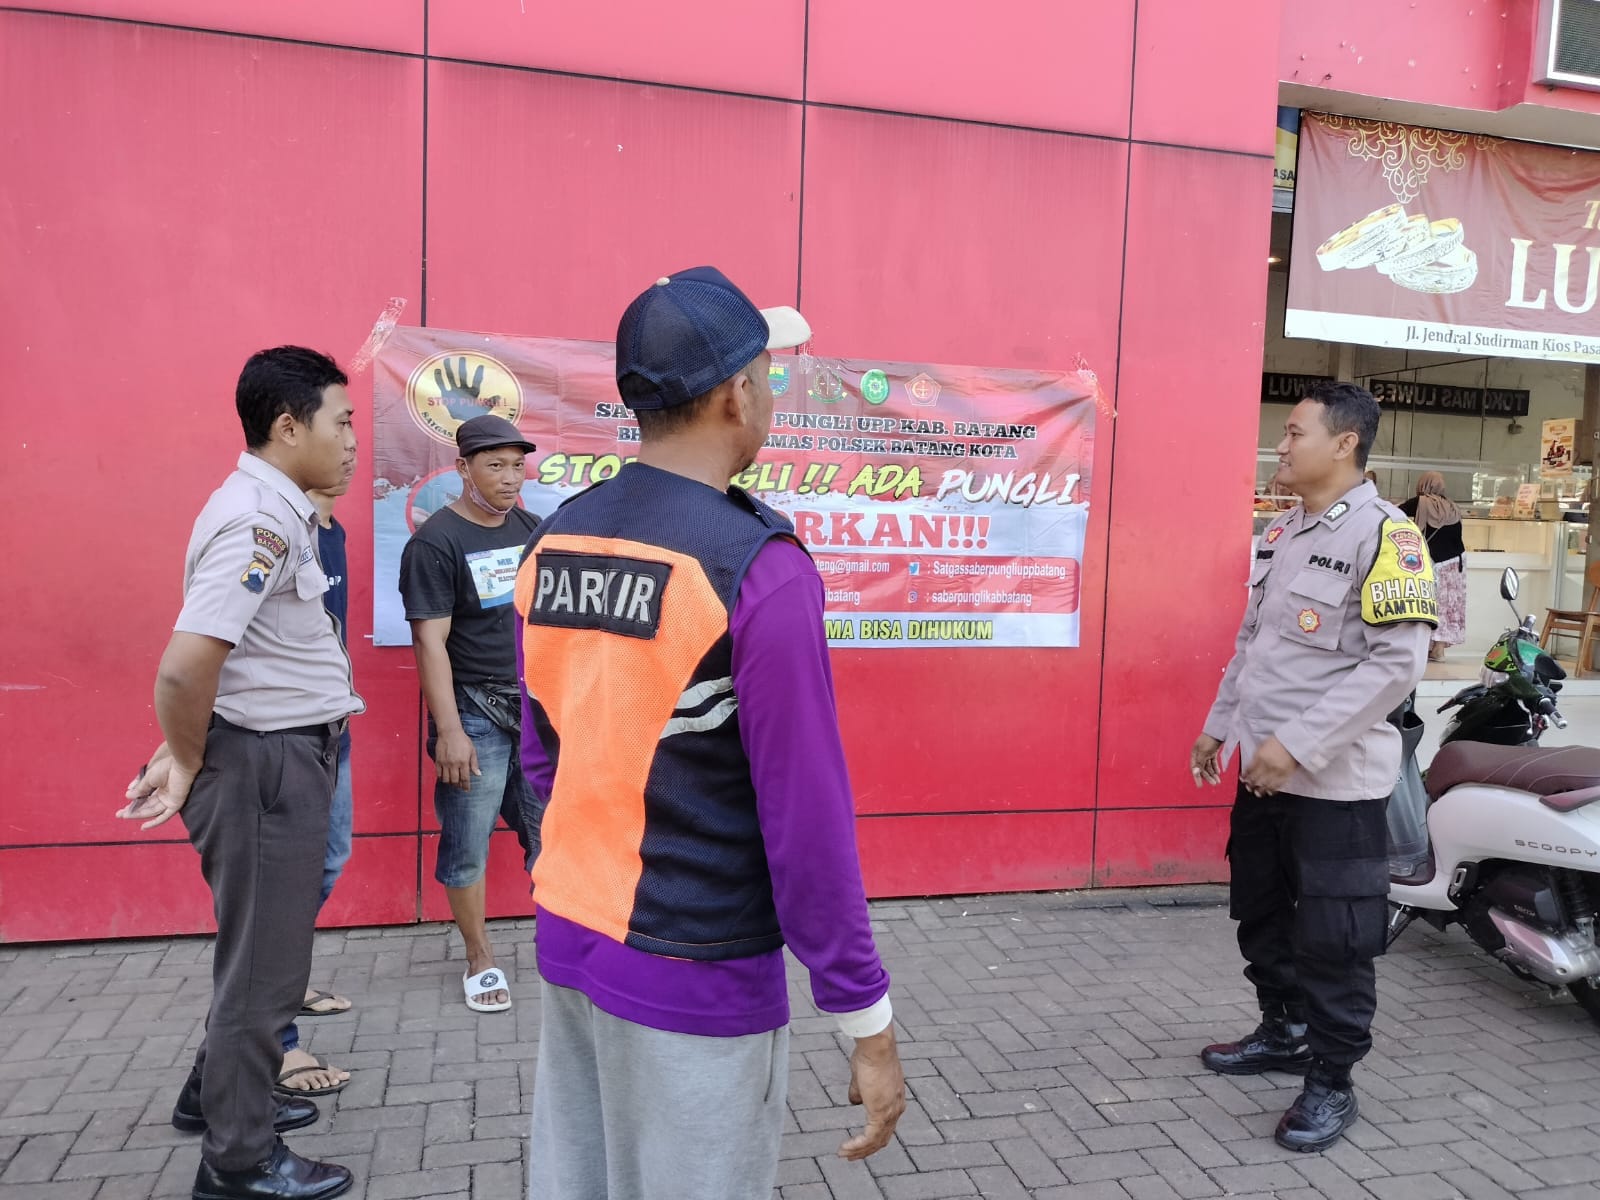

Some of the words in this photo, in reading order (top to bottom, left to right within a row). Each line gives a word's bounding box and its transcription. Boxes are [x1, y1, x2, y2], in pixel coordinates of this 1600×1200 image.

[1583, 200, 1600, 230] T
[1504, 236, 1600, 314] LU
[1405, 325, 1420, 341] Jl.
[1422, 327, 1471, 346] Jendral
[1474, 331, 1538, 351] Sudirman
[1542, 337, 1571, 354] Kios
[1268, 376, 1306, 397] LUW
[427, 397, 457, 407] STOP
[421, 410, 454, 438] SATGAS
[774, 412, 853, 431] PUNGLI
[857, 416, 896, 433] UPP
[899, 418, 949, 436] KAB.
[953, 421, 1037, 440] BATANG
[817, 436, 887, 454] POLSEK
[890, 439, 965, 457] BATANG
[969, 444, 1018, 460] KOTA
[539, 453, 638, 485] STO
[848, 463, 924, 499] ADA
[936, 469, 1081, 508] PUNGLI
[255, 528, 286, 552] POLRES
[814, 559, 891, 574] teng@gmail.com
[932, 560, 1066, 578] Satgassaberpungliuppbatang
[1308, 554, 1351, 575] POLRI
[534, 568, 656, 623] PARKIR
[931, 590, 1033, 606] saberpunglikabbatang
[859, 619, 904, 640] BISA
[907, 619, 994, 641] DIHUKUM
[1514, 839, 1598, 857] SCOOPY
